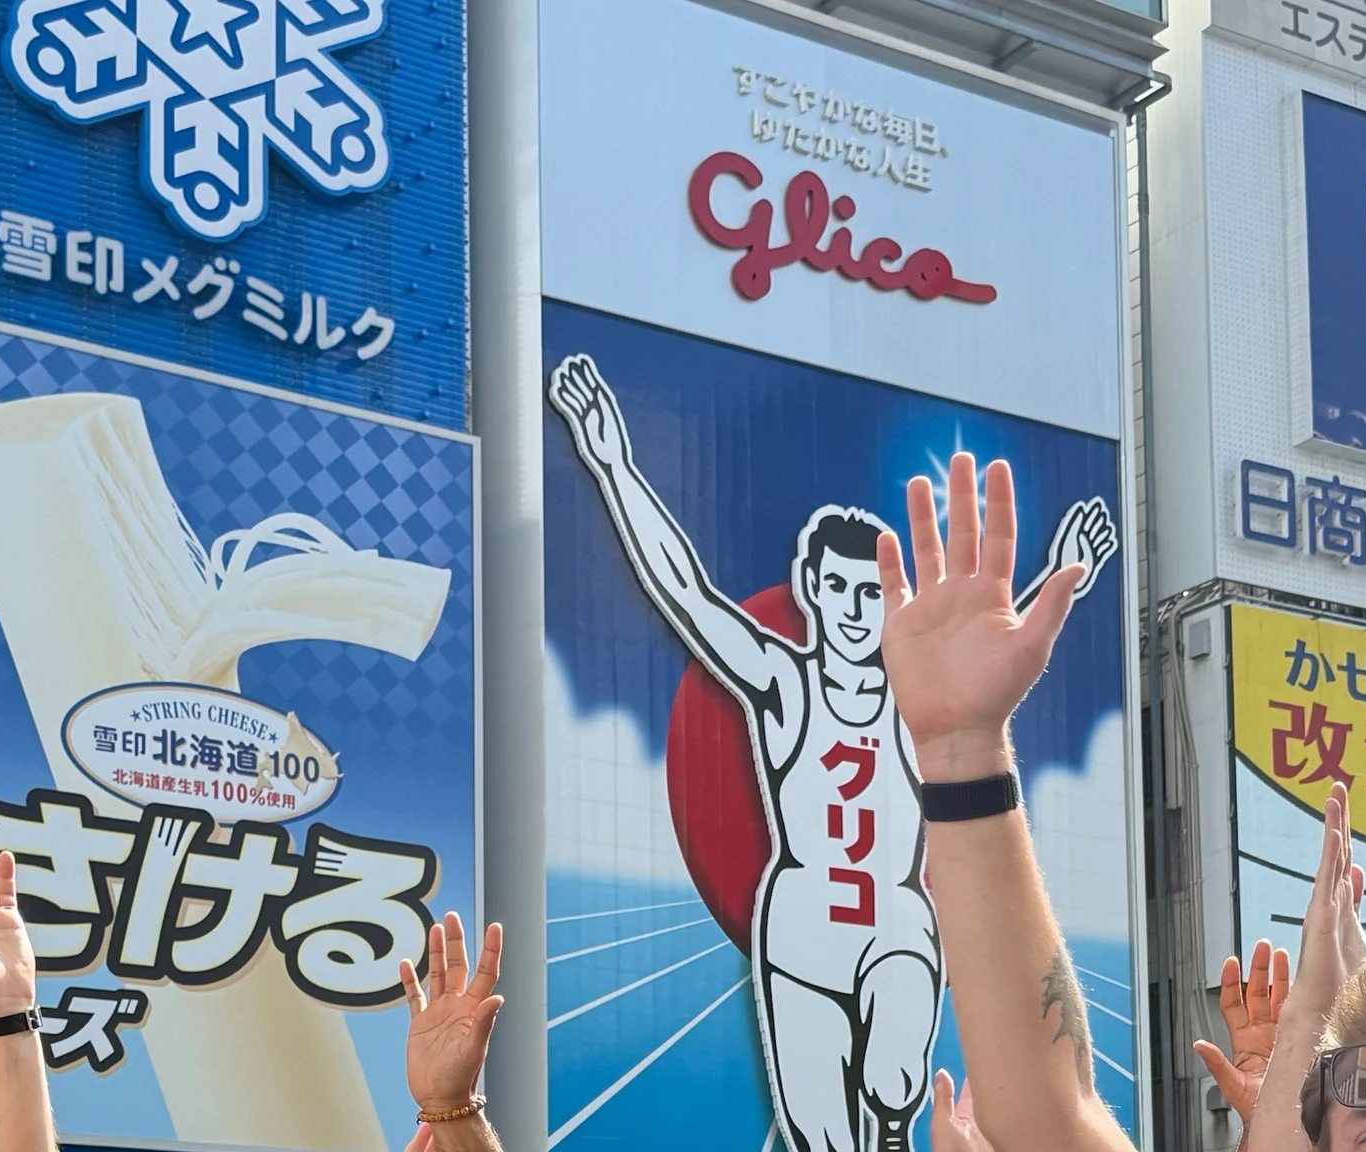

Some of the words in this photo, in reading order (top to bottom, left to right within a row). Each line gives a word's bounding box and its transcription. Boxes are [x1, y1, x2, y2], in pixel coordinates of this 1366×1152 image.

[750, 108, 933, 192] ゆたかな人生
[688, 150, 998, 301] Glico
[141, 701, 202, 723] STRING
[207, 704, 270, 741] CHEESE
[112, 768, 296, 810] 北海道産生乳100%使用
[818, 735, 880, 928] グリコ
